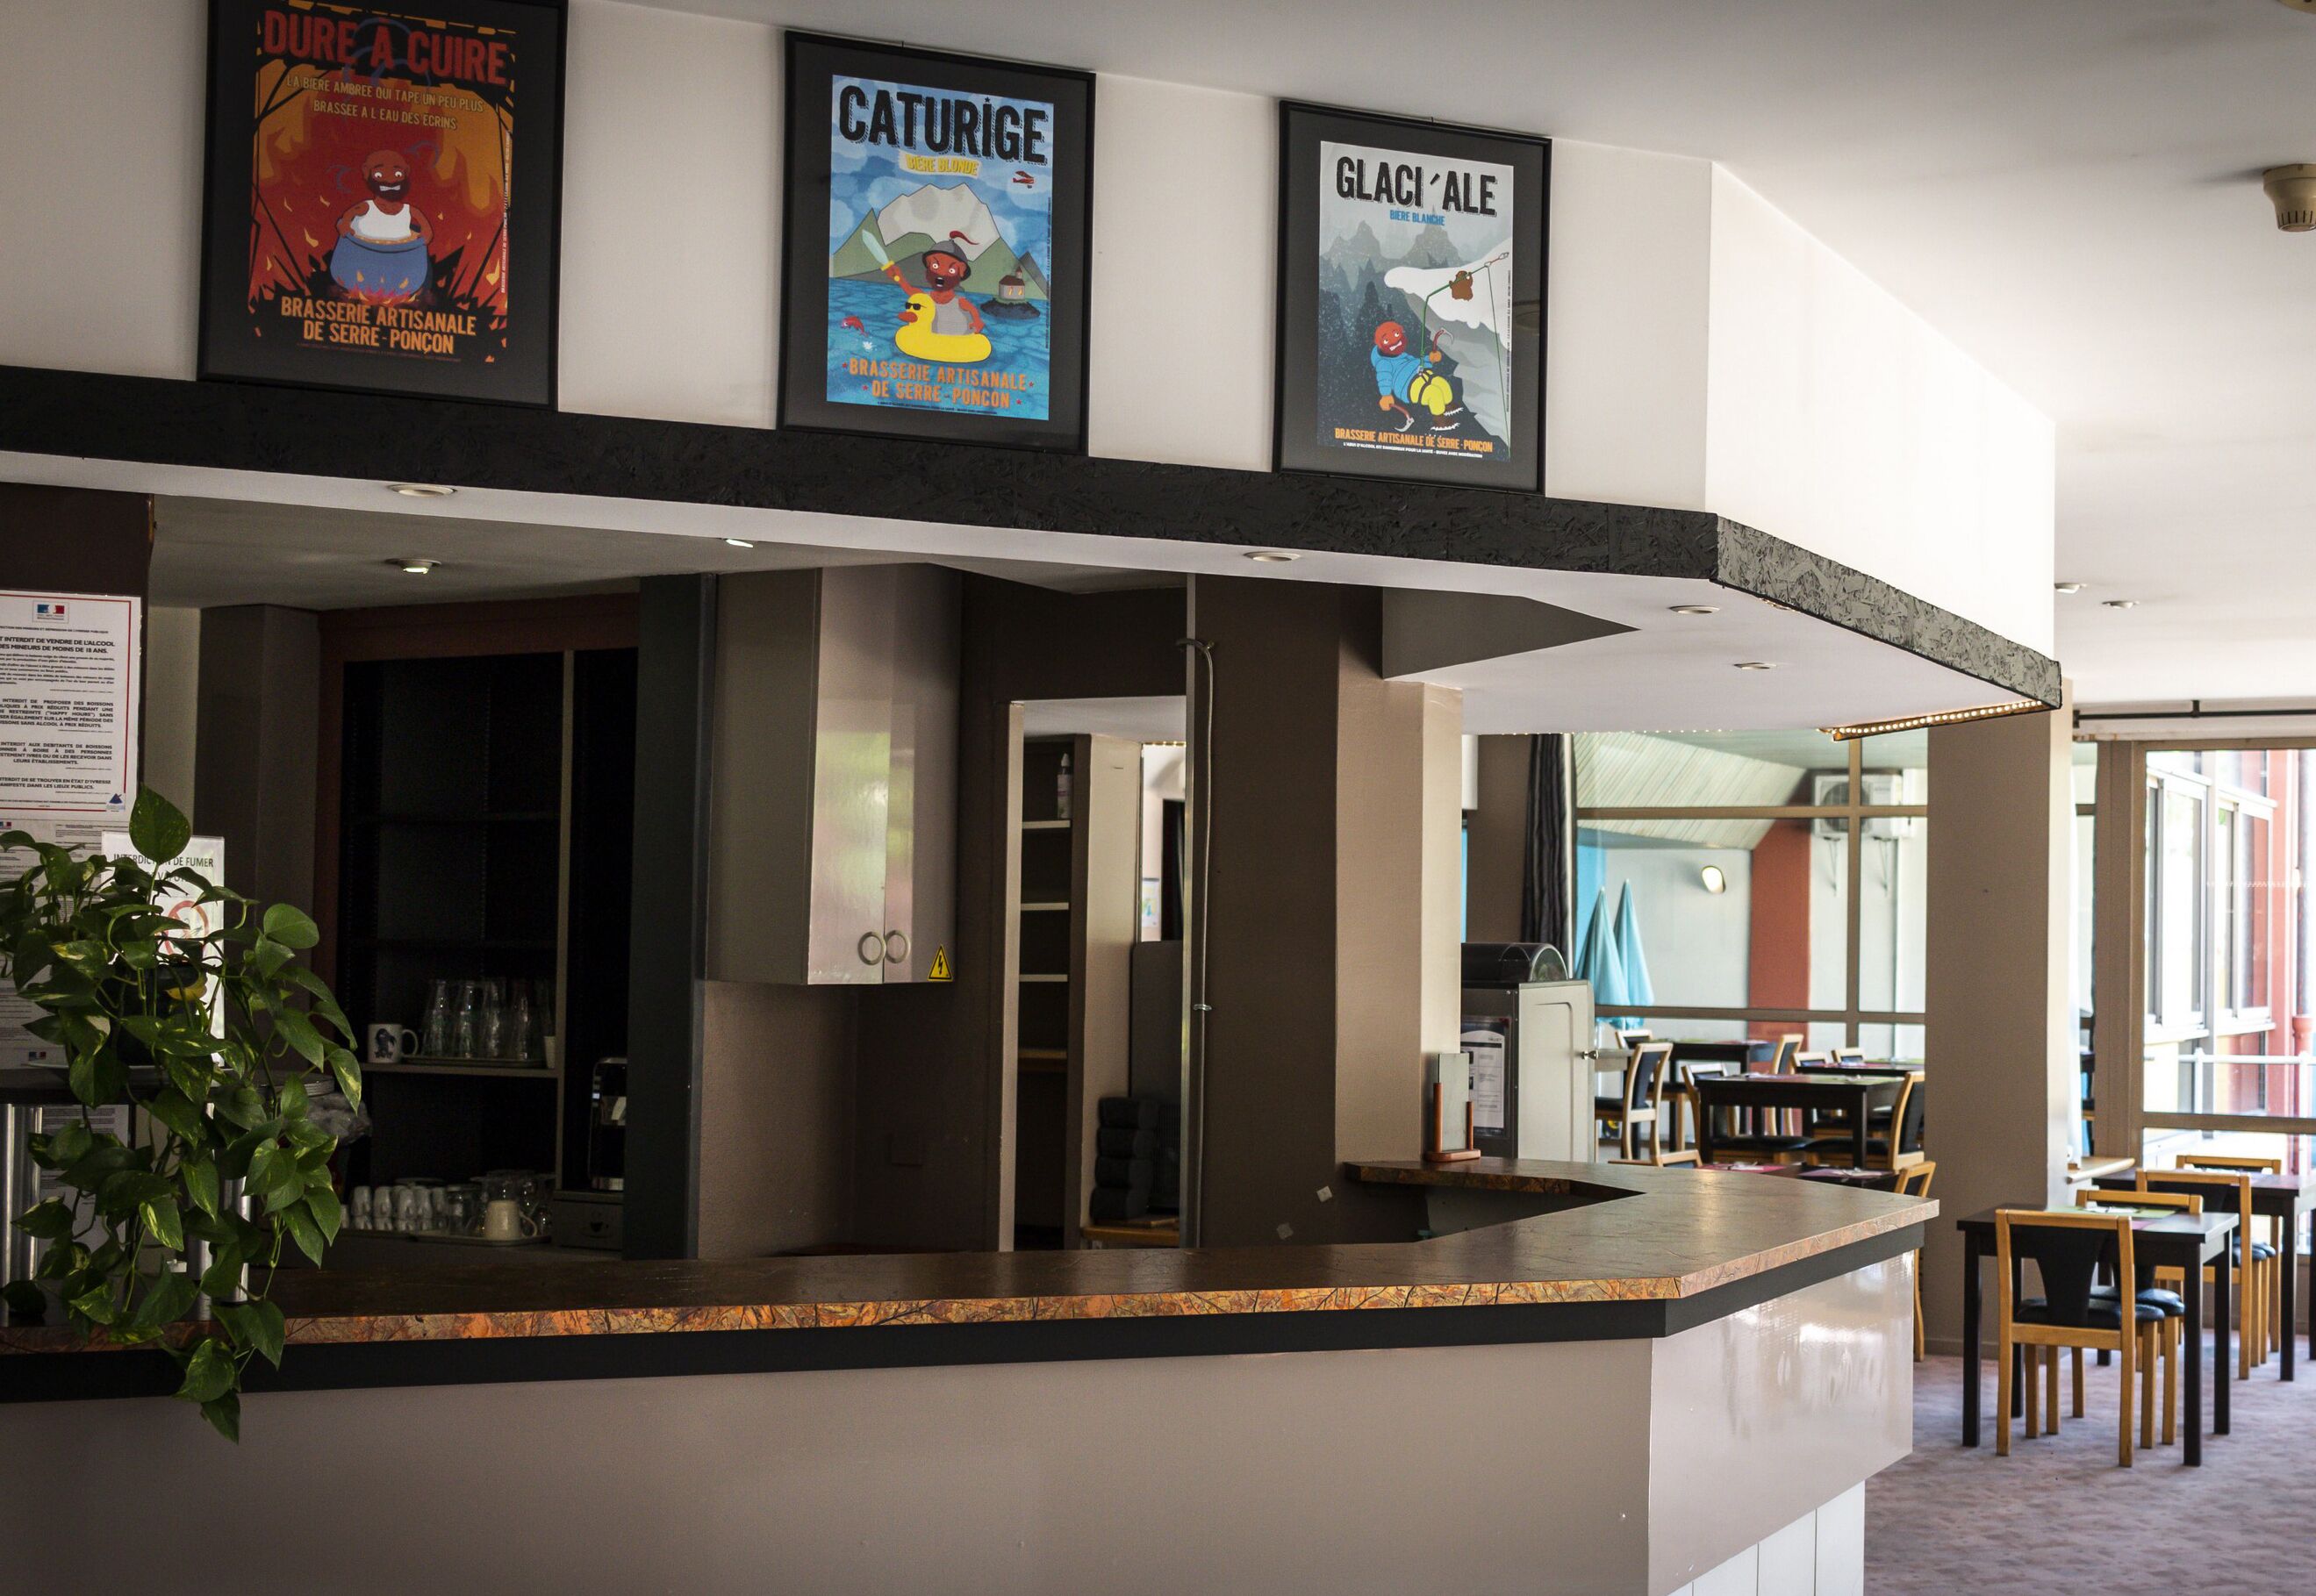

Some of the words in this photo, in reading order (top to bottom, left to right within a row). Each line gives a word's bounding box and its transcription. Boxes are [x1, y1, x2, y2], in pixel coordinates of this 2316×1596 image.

[263, 10, 358, 64] DURE
[407, 30, 507, 85] CUIRE
[287, 75, 300, 87] LA
[376, 86, 392, 100] QUI
[396, 89, 420, 103] TAPE
[422, 93, 436, 105] UN
[439, 96, 456, 109] PEU
[459, 98, 484, 112] PLUS
[401, 111, 419, 125] DES
[840, 85, 1048, 165] CATURIGE
[938, 157, 979, 175] BLONDE
[1412, 211, 1445, 226] BLANCHE
[281, 296, 371, 325] BRASSERIE
[376, 306, 477, 336] ARTISANALE
[303, 319, 324, 341] DE
[850, 357, 930, 382] BRASSERIE
[937, 366, 1026, 391] ARTISANALE
[871, 379, 890, 397] DE
[1335, 427, 1376, 442] BRASSERIE
[1378, 432, 1424, 447] ARTISANALE
[1425, 436, 1435, 447] DE
[186, 859, 214, 868] FUMER
